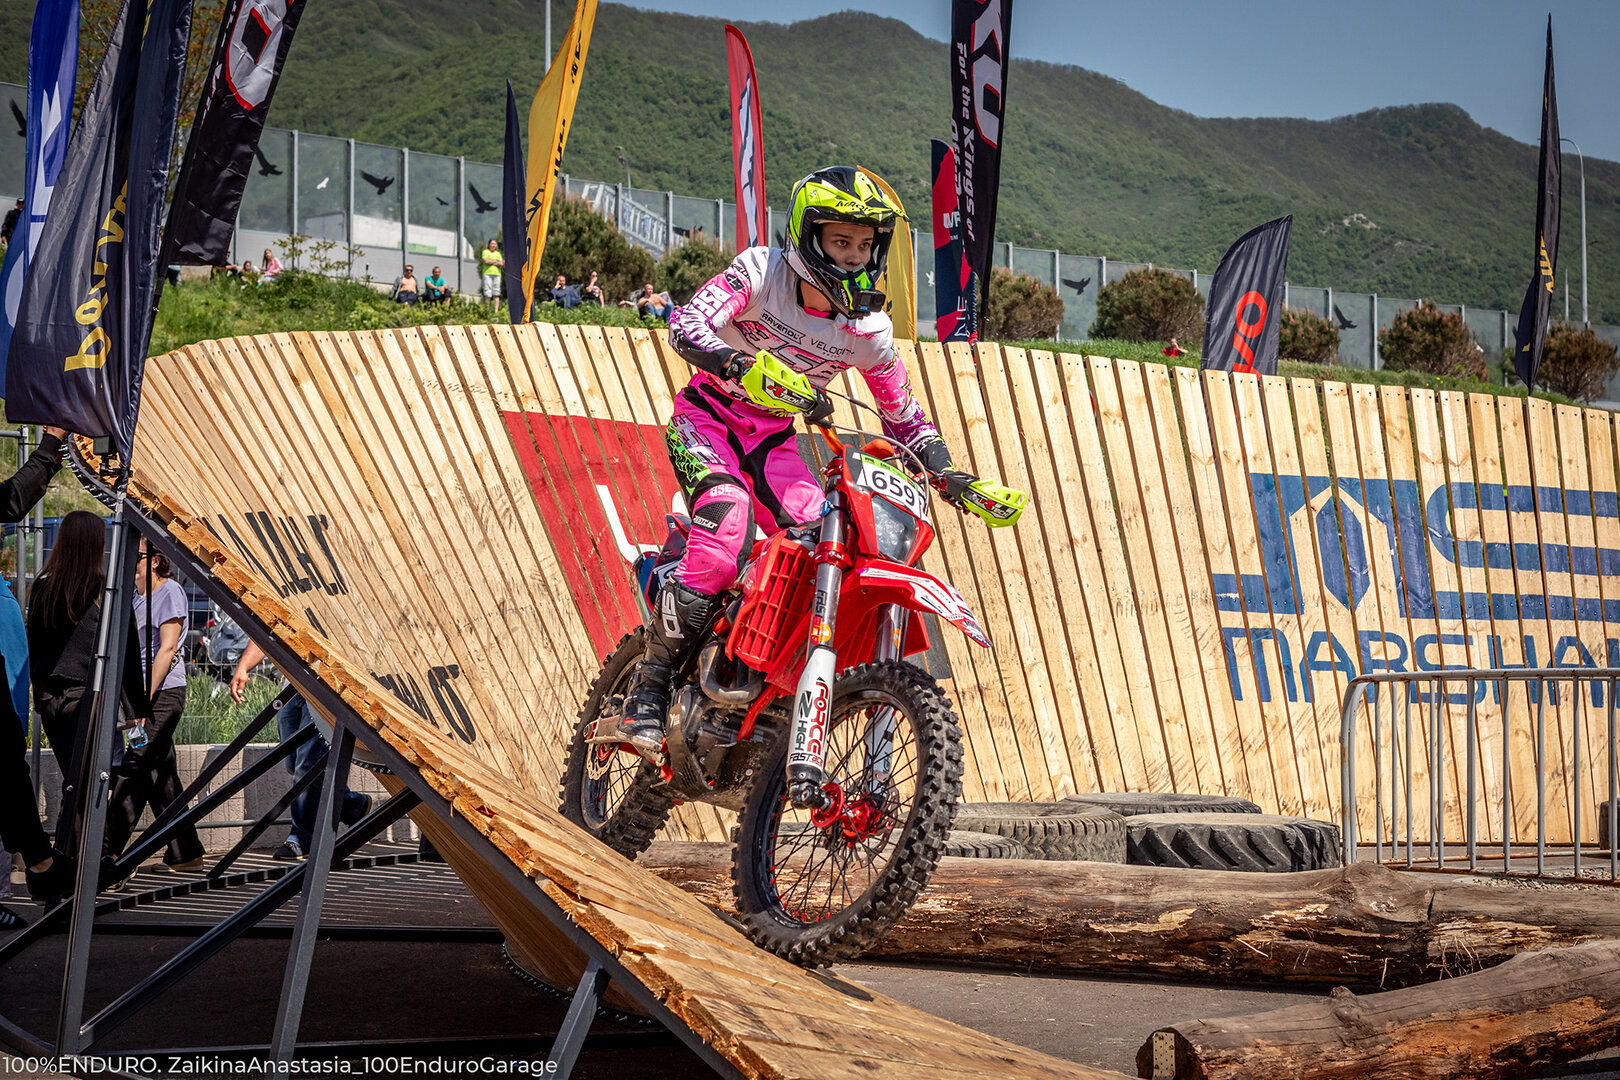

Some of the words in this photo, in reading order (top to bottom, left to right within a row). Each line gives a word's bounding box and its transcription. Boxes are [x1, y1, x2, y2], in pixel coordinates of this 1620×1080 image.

[961, 84, 972, 121] the
[962, 126, 976, 217] Kings
[871, 470, 916, 507] 659
